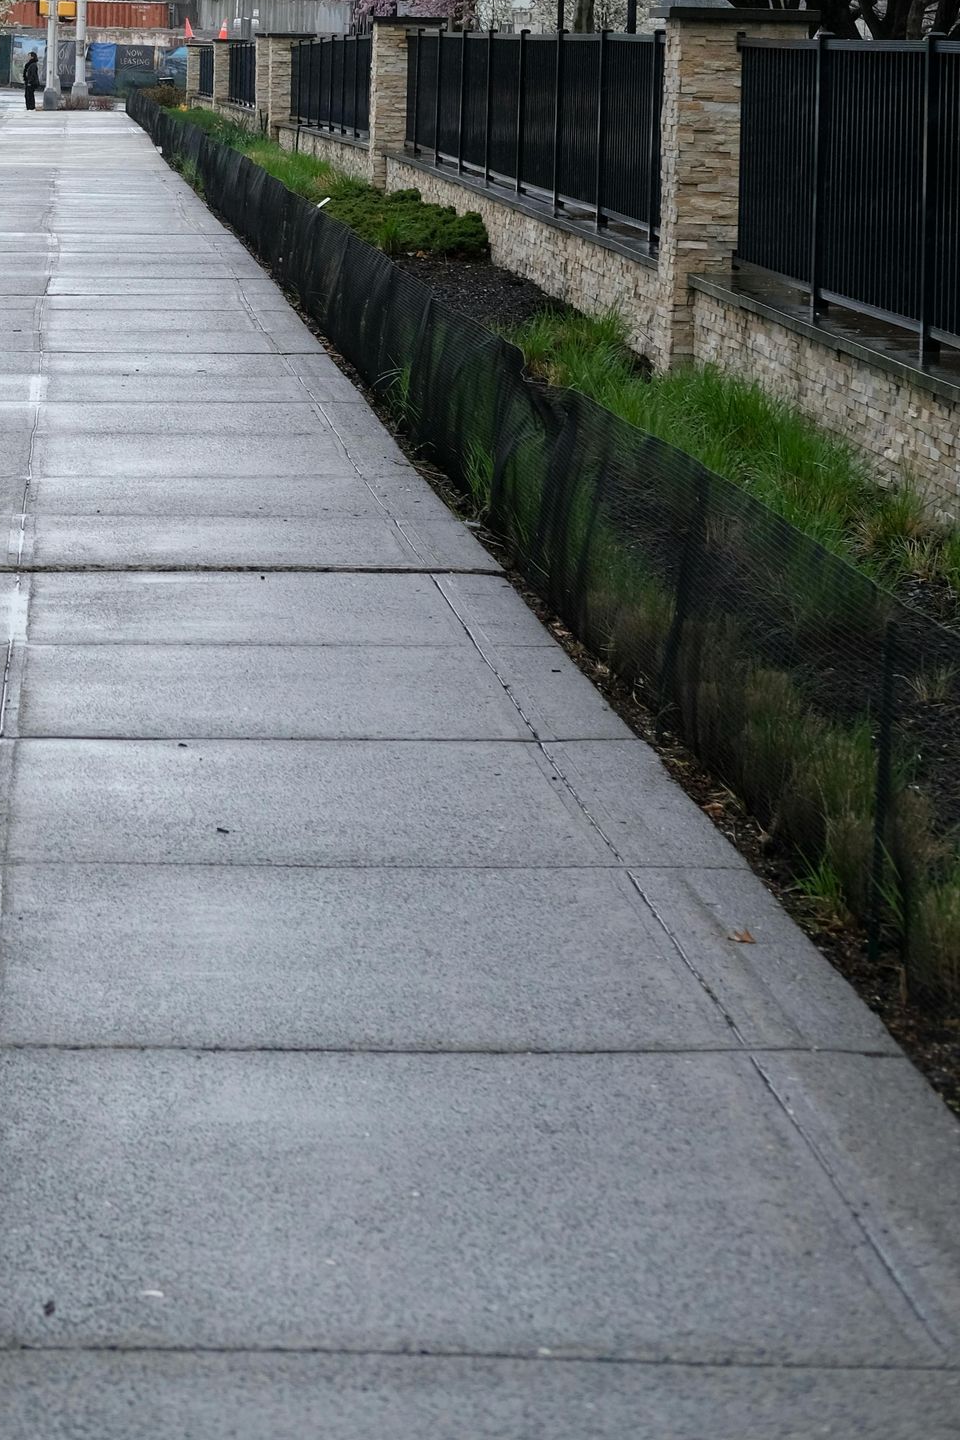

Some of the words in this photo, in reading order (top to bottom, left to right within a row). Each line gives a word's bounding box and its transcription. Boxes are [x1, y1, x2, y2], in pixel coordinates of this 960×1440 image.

[126, 49, 144, 57] NOW
[120, 58, 150, 66] LEASING
[58, 63, 75, 75] SING
